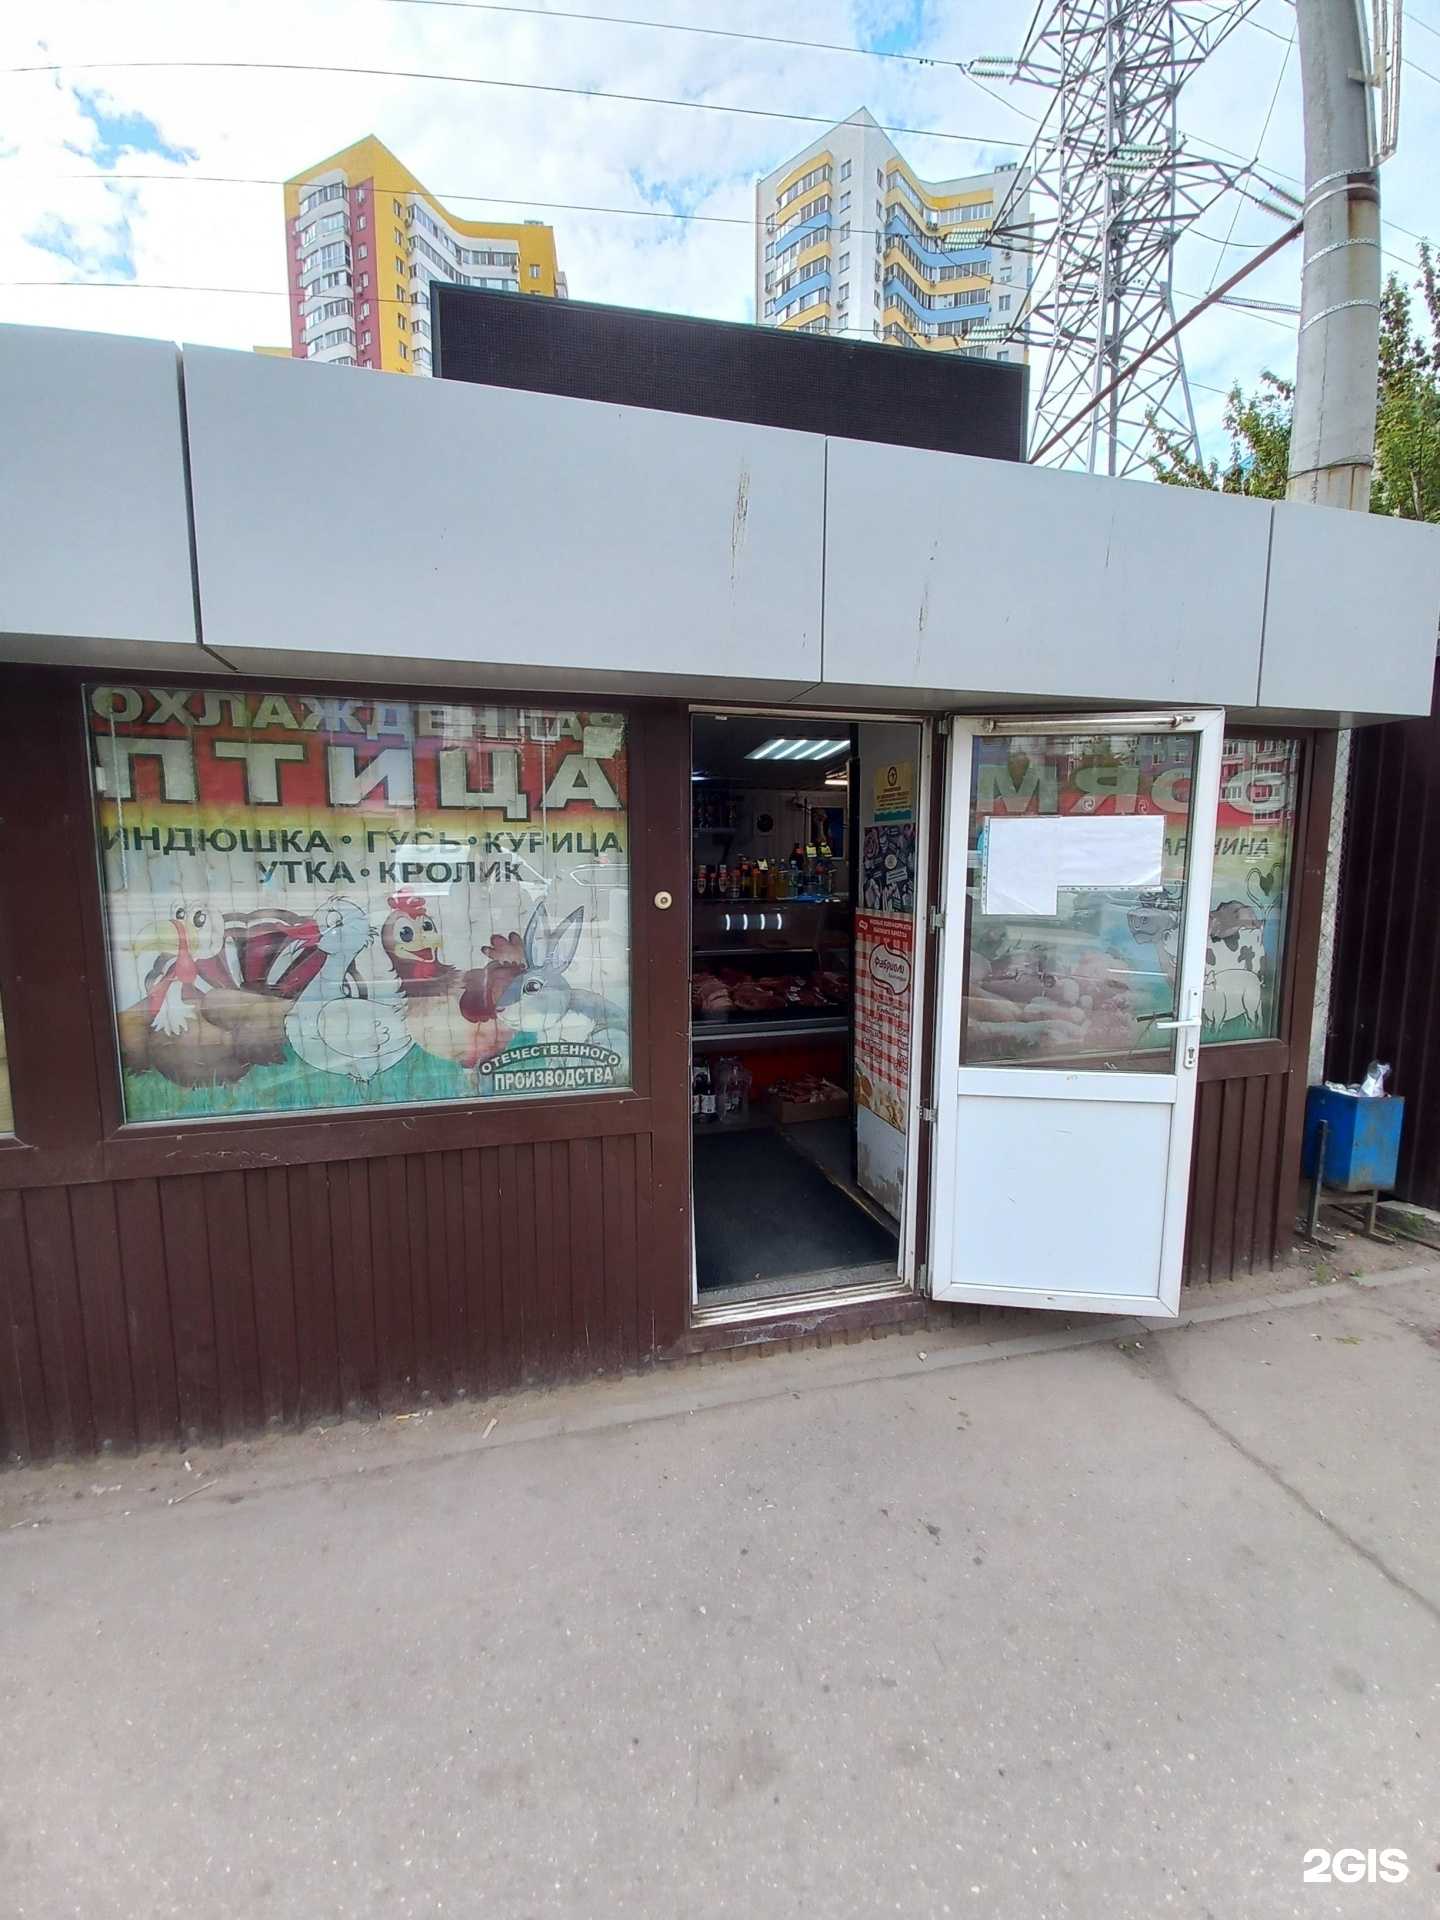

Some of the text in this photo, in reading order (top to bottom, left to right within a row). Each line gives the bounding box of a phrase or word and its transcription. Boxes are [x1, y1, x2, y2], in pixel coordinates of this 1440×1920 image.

[95, 735, 622, 822] ПТИЦА
[978, 763, 1286, 815] МЯСО
[103, 826, 622, 857] ИНДЮШКА ГУСЬ КУРИЦА
[258, 860, 524, 885] УТКА КРОЛИК
[481, 1043, 620, 1074] ОТЕЧЕСТВЕННОГО
[494, 1066, 614, 1091] ПРОИЗВОДСТВА
